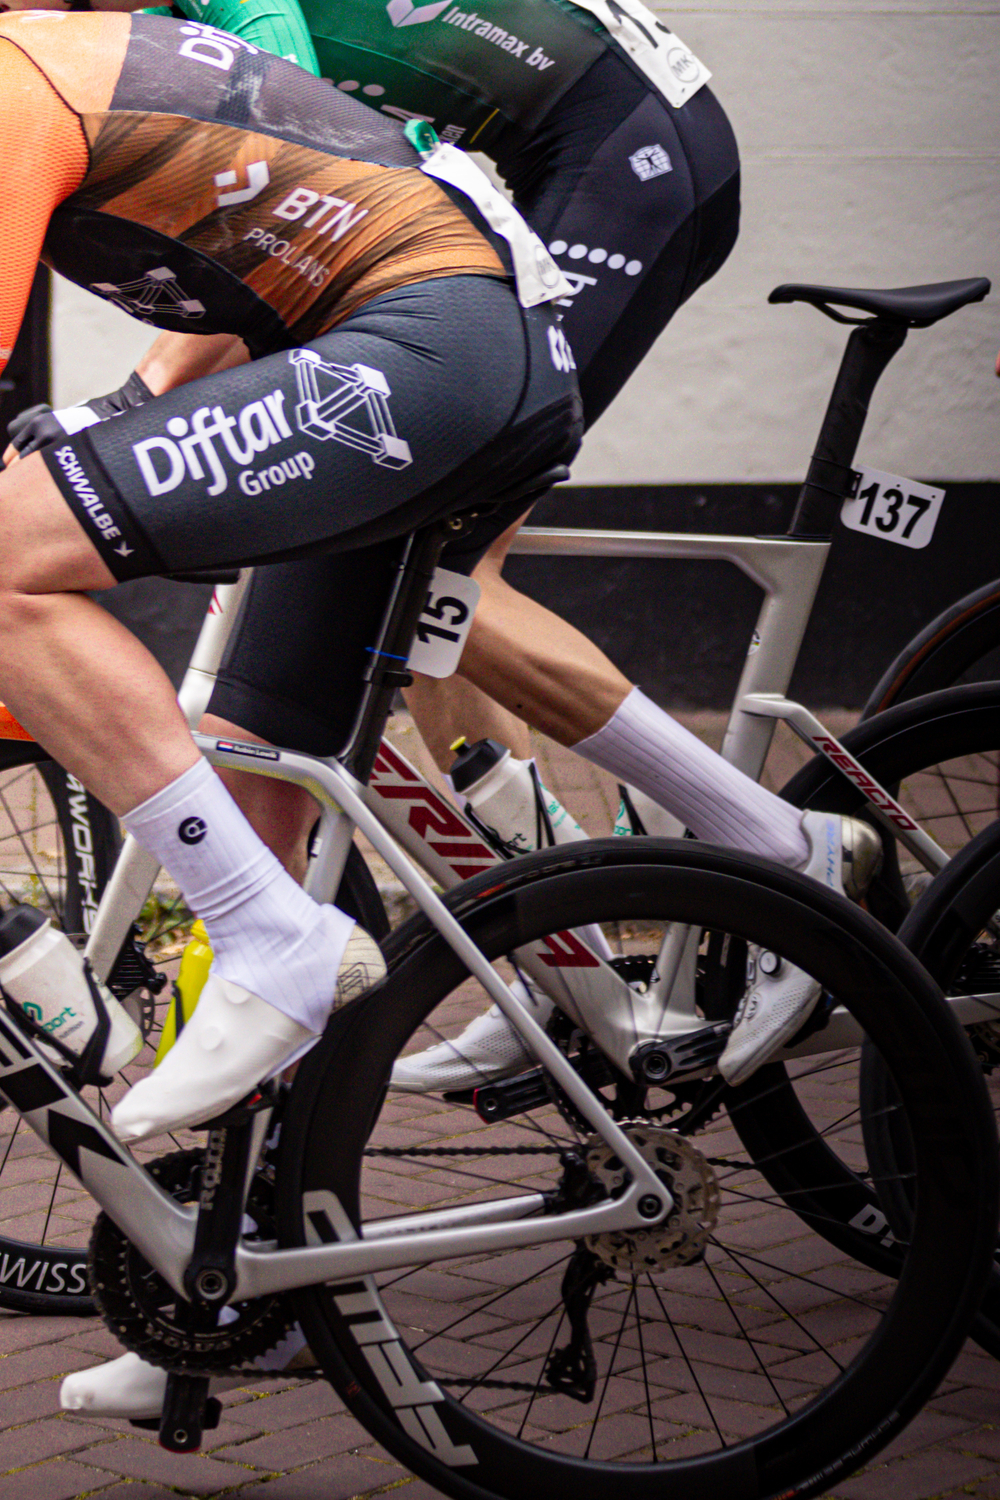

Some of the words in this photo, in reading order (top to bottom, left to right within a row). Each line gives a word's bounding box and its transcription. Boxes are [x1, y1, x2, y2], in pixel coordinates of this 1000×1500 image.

[441, 6, 531, 58] Intramax
[525, 47, 556, 71] bv
[272, 187, 370, 242] BTN
[132, 390, 294, 497] Diftar
[238, 451, 316, 496] Group
[55, 445, 122, 541] SCHWALBE
[858, 482, 932, 540] 137
[416, 592, 469, 644] 15
[811, 736, 918, 831] REACTO
